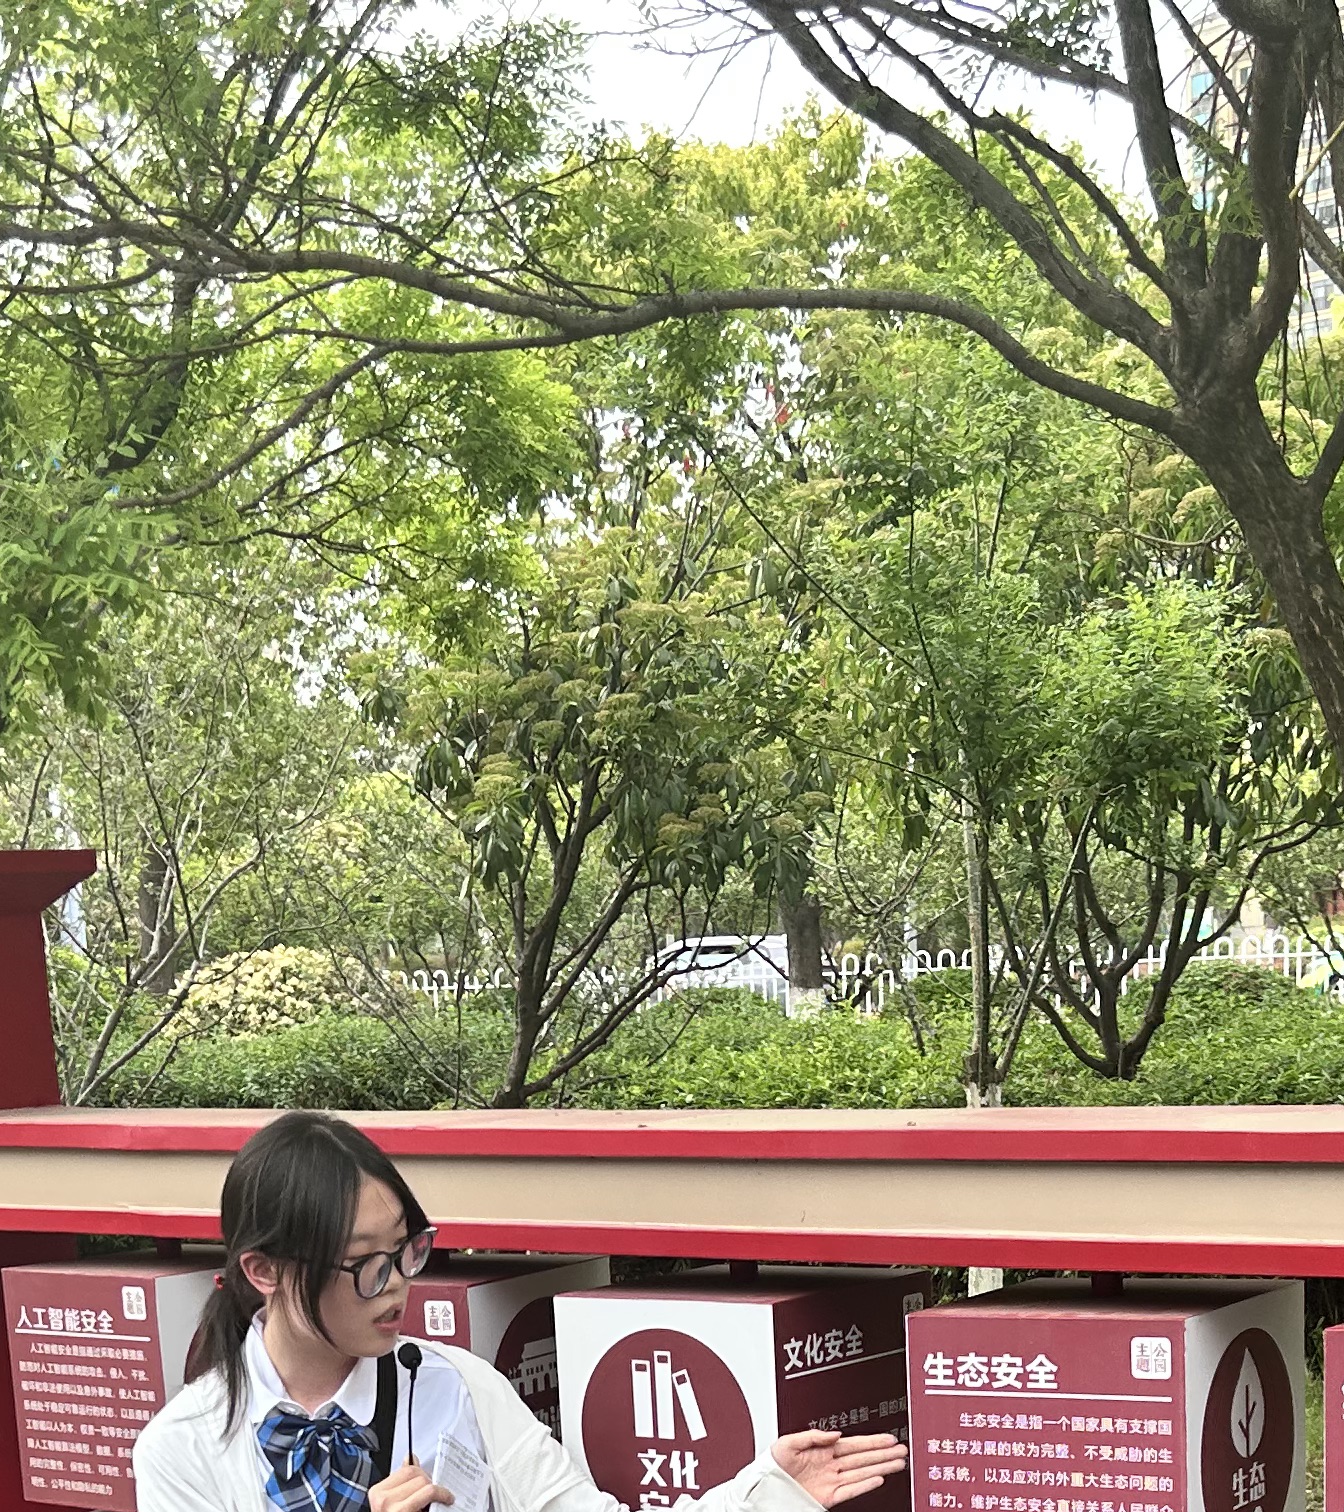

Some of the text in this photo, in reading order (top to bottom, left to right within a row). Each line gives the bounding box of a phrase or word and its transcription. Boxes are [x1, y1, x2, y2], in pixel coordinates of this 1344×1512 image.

[17, 1306, 114, 1334] 人工智能安全
[783, 1324, 864, 1372] 文化安全
[923, 1353, 1058, 1389] 生态安全
[638, 1449, 700, 1489] 文化
[1232, 1461, 1266, 1511] 生态
